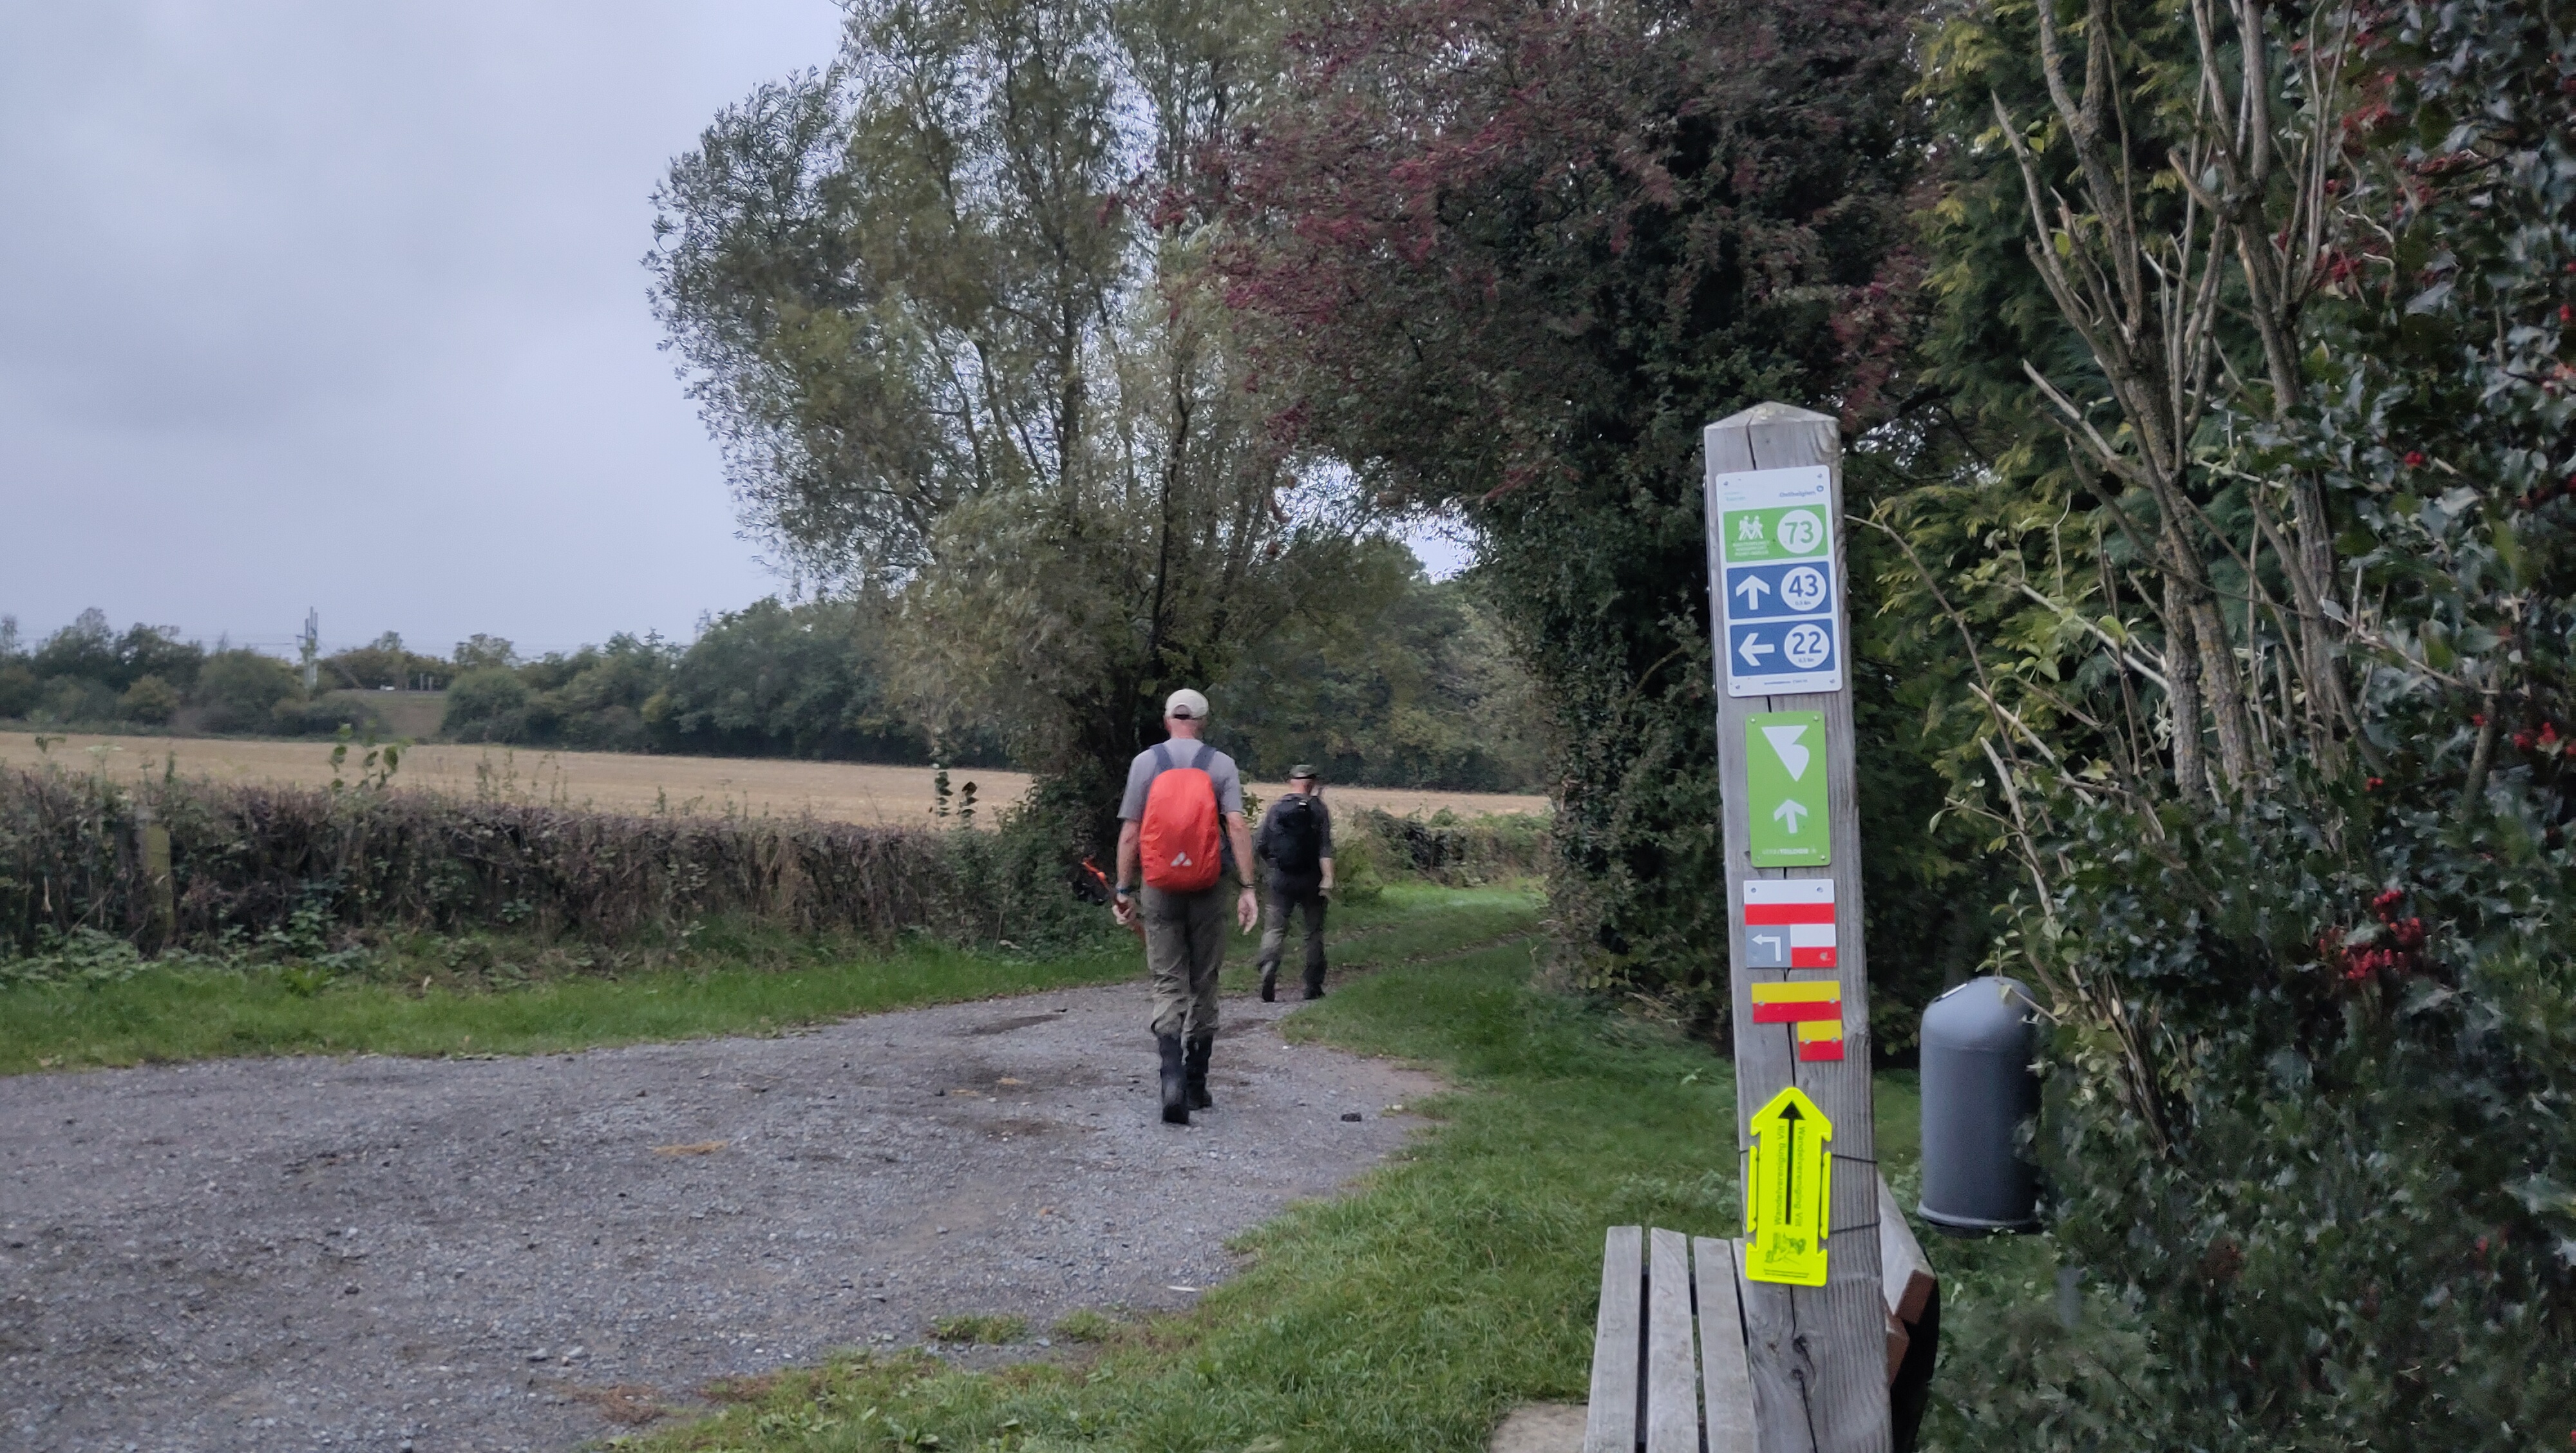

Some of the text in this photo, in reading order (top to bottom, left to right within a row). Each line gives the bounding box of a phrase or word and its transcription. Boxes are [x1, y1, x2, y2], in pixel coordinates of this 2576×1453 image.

[1785, 520, 1814, 545] 73
[1788, 574, 1819, 598] 43
[1792, 631, 1823, 655] 22
[1794, 1126, 1806, 1209] Wandelvereniging
[1774, 1143, 1786, 1226] Wandelvereniging
